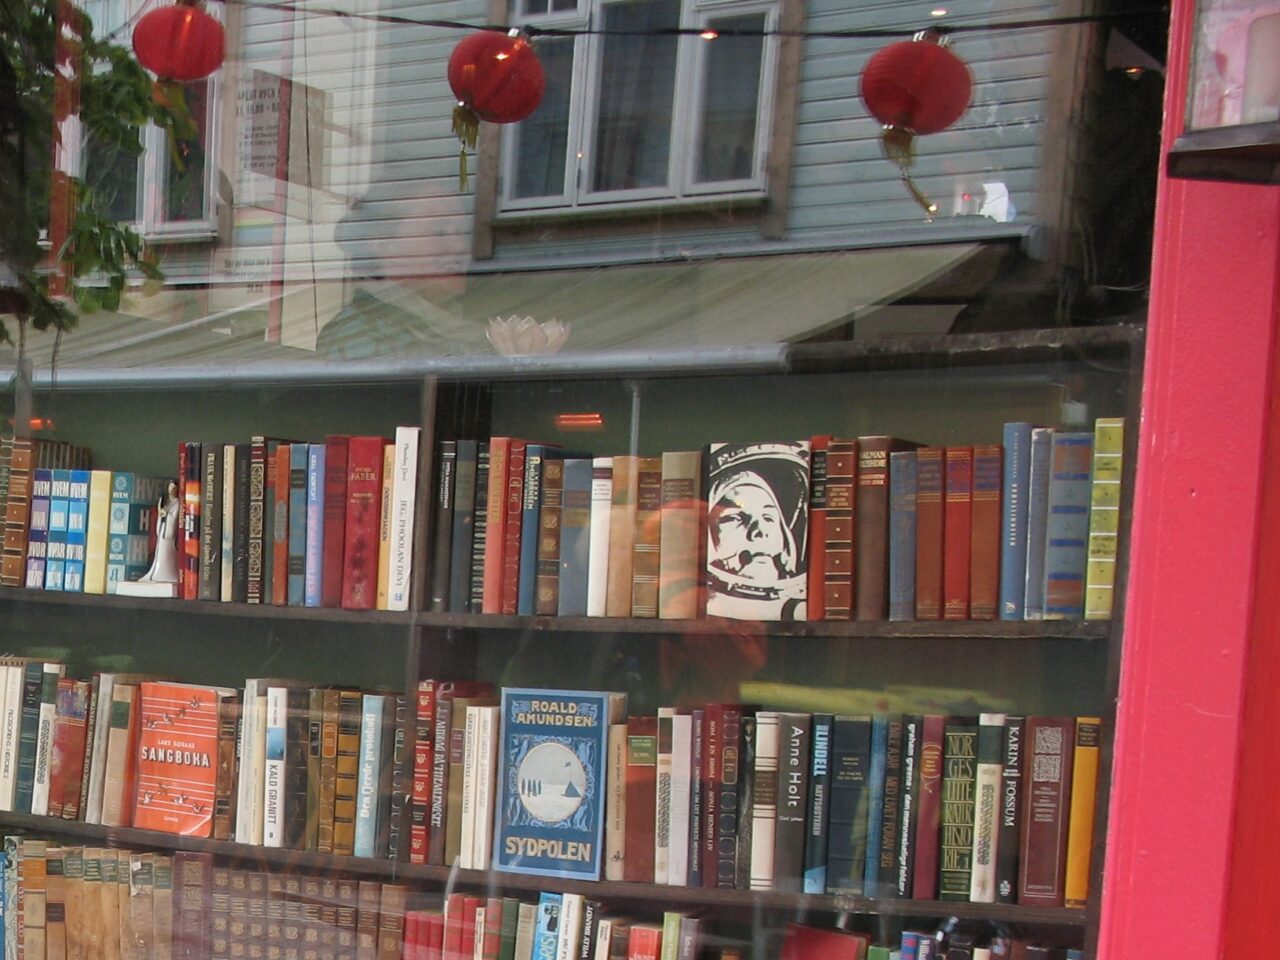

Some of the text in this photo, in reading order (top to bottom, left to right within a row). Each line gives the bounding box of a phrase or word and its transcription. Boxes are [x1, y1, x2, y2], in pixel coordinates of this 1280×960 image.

[207, 453, 215, 473] FRANK
[859, 451, 886, 459] SALMAN
[351, 472, 376, 480] FABER
[34, 481, 50, 496] HVEM
[52, 481, 69, 496] HVEM
[70, 483, 87, 497] HVEM
[397, 519, 407, 562] PHOOLAN
[396, 565, 405, 586] DEVI
[531, 700, 577, 714] ROALD
[6, 709, 14, 747] FILOSOFIENS
[516, 713, 593, 727] AMUNDSEN
[434, 720, 446, 764] MIDDAG PÅ
[709, 745, 715, 755] EN
[907, 723, 916, 756] graham
[948, 735, 972, 756] NOR
[3, 748, 11, 774] HISTORIE
[142, 747, 210, 768] SANGBOKA
[813, 732, 828, 776] LINDELL
[360, 714, 376, 818] Den fjerde protokoll
[787, 726, 804, 806] Anne Holt
[905, 757, 914, 786] greene
[948, 759, 972, 779] GES
[1004, 726, 1020, 827] KARIN FOSSUM
[267, 764, 278, 824] KALD GRANITT
[880, 722, 900, 867] EMILE AJAR MED LIVET FORAN SEG
[904, 794, 913, 809] den
[505, 836, 592, 863] SYDPOLEN
[581, 906, 593, 958] WILLY BRANDT
